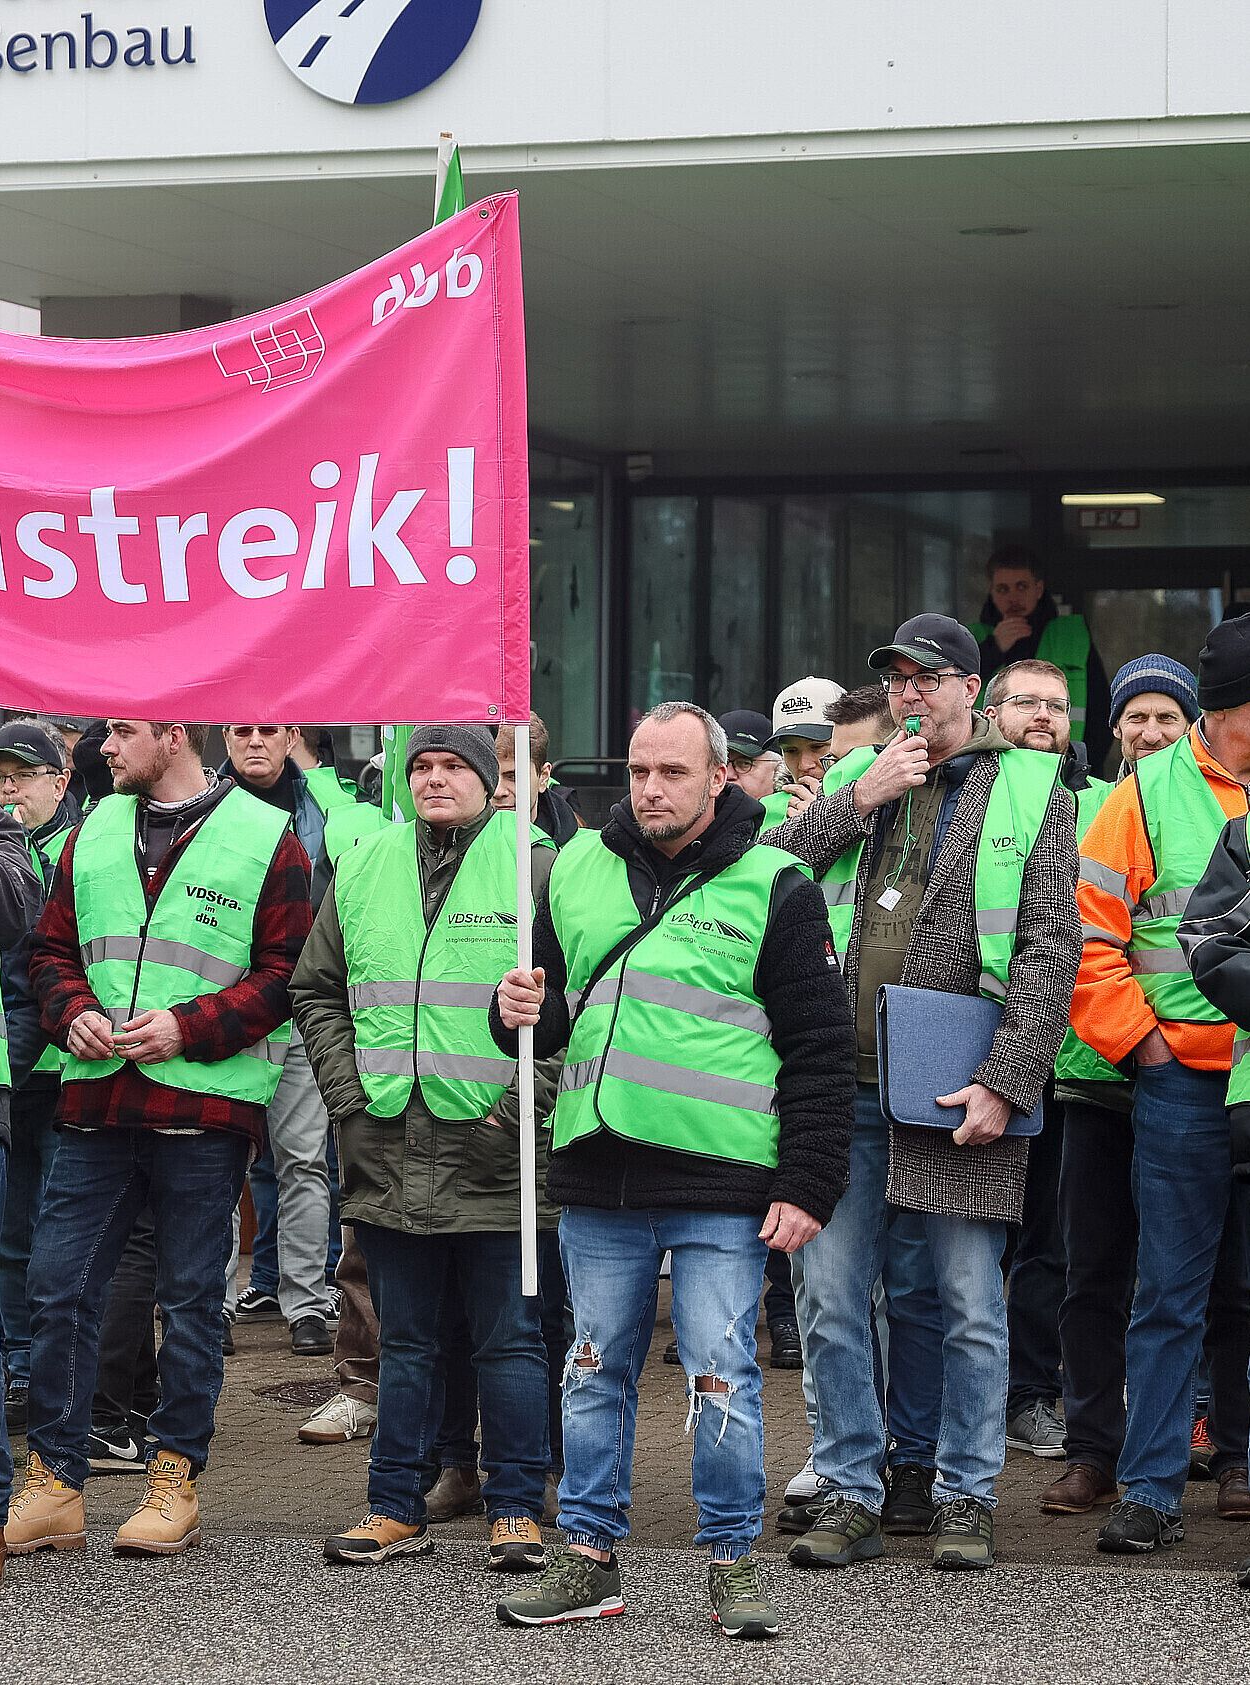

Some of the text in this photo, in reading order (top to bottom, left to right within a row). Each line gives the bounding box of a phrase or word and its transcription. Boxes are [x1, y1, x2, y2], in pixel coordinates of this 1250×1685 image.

[371, 245, 483, 327] dbb
[186, 886, 241, 911] VDStra.
[205, 905, 214, 913] im
[195, 913, 217, 927] dbb
[448, 914, 495, 924] VDStra.
[672, 913, 714, 932] VDStra.
